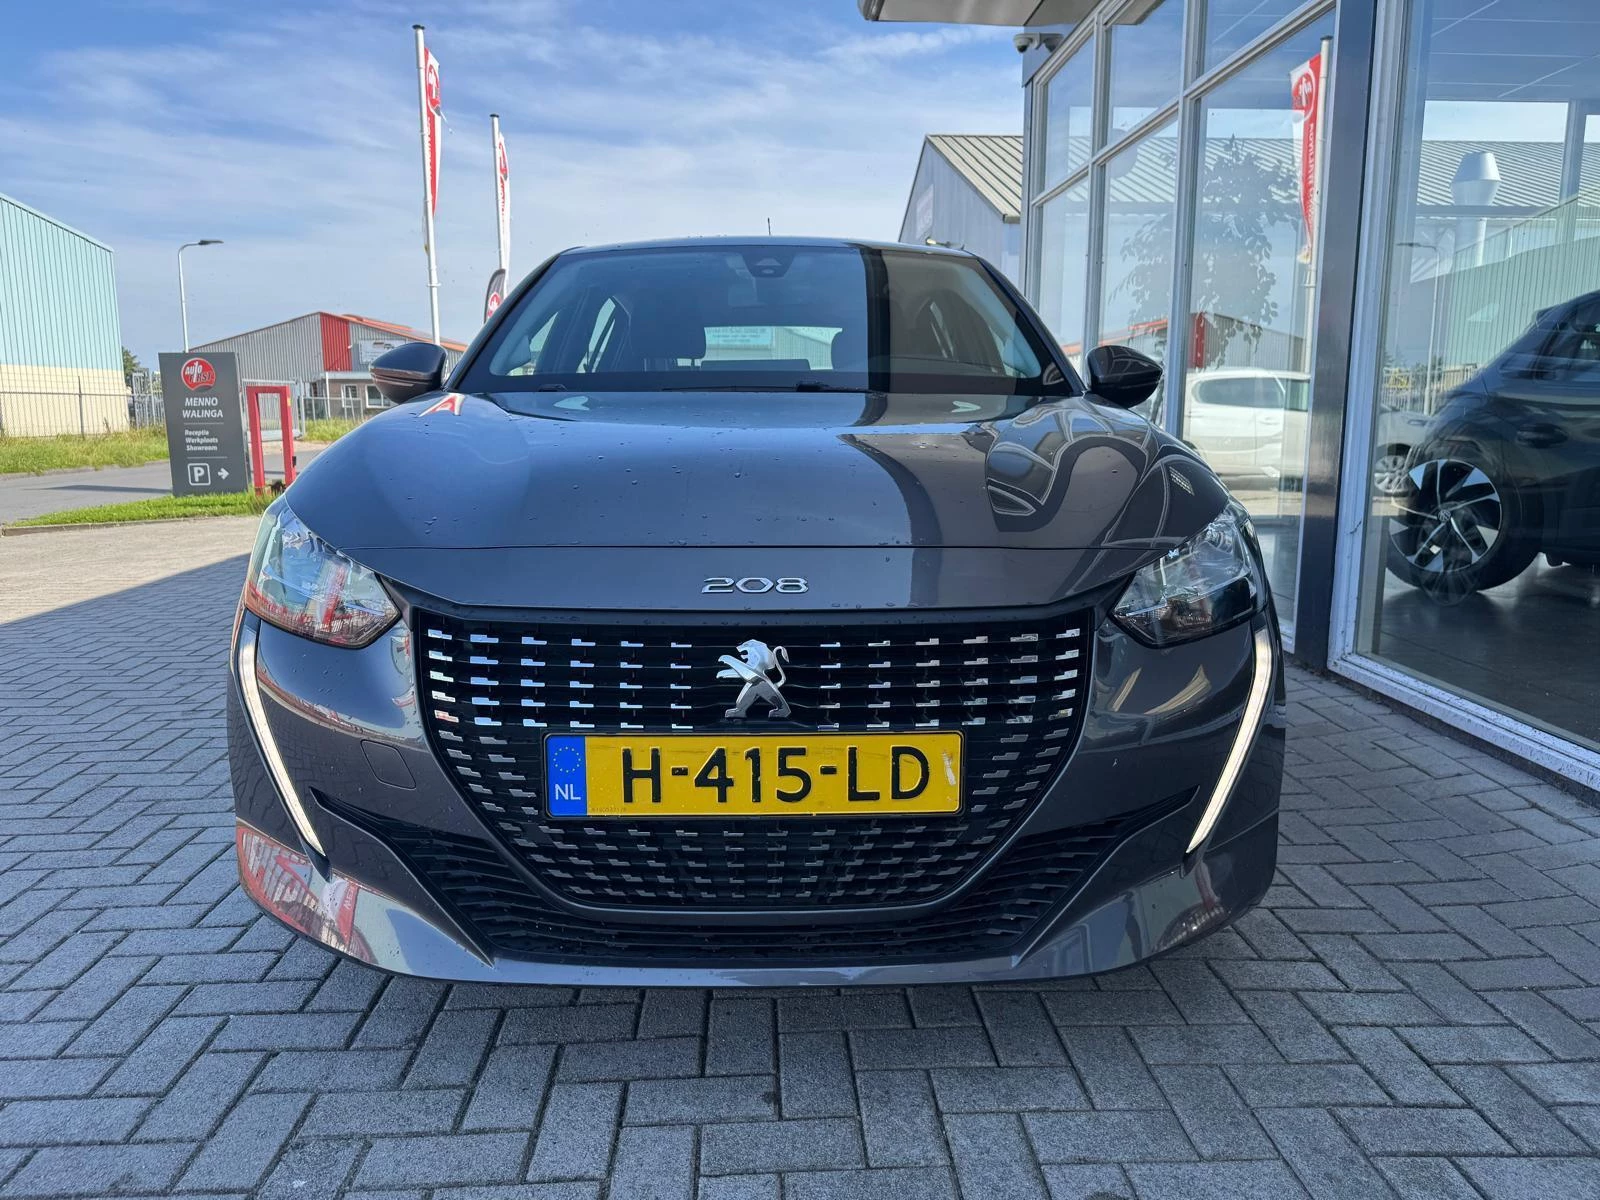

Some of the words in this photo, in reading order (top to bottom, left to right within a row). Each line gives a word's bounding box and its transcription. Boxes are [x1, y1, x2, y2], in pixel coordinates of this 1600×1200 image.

[184, 397, 218, 406] MENNO
[182, 409, 223, 418] WALINGA
[184, 429, 209, 437] Receptie
[185, 436, 219, 444] Werkplaats
[186, 444, 218, 452] Showroom
[193, 466, 205, 482] P
[701, 576, 809, 594] 208
[621, 744, 931, 804] H-415-LD
[554, 783, 582, 802] NL
